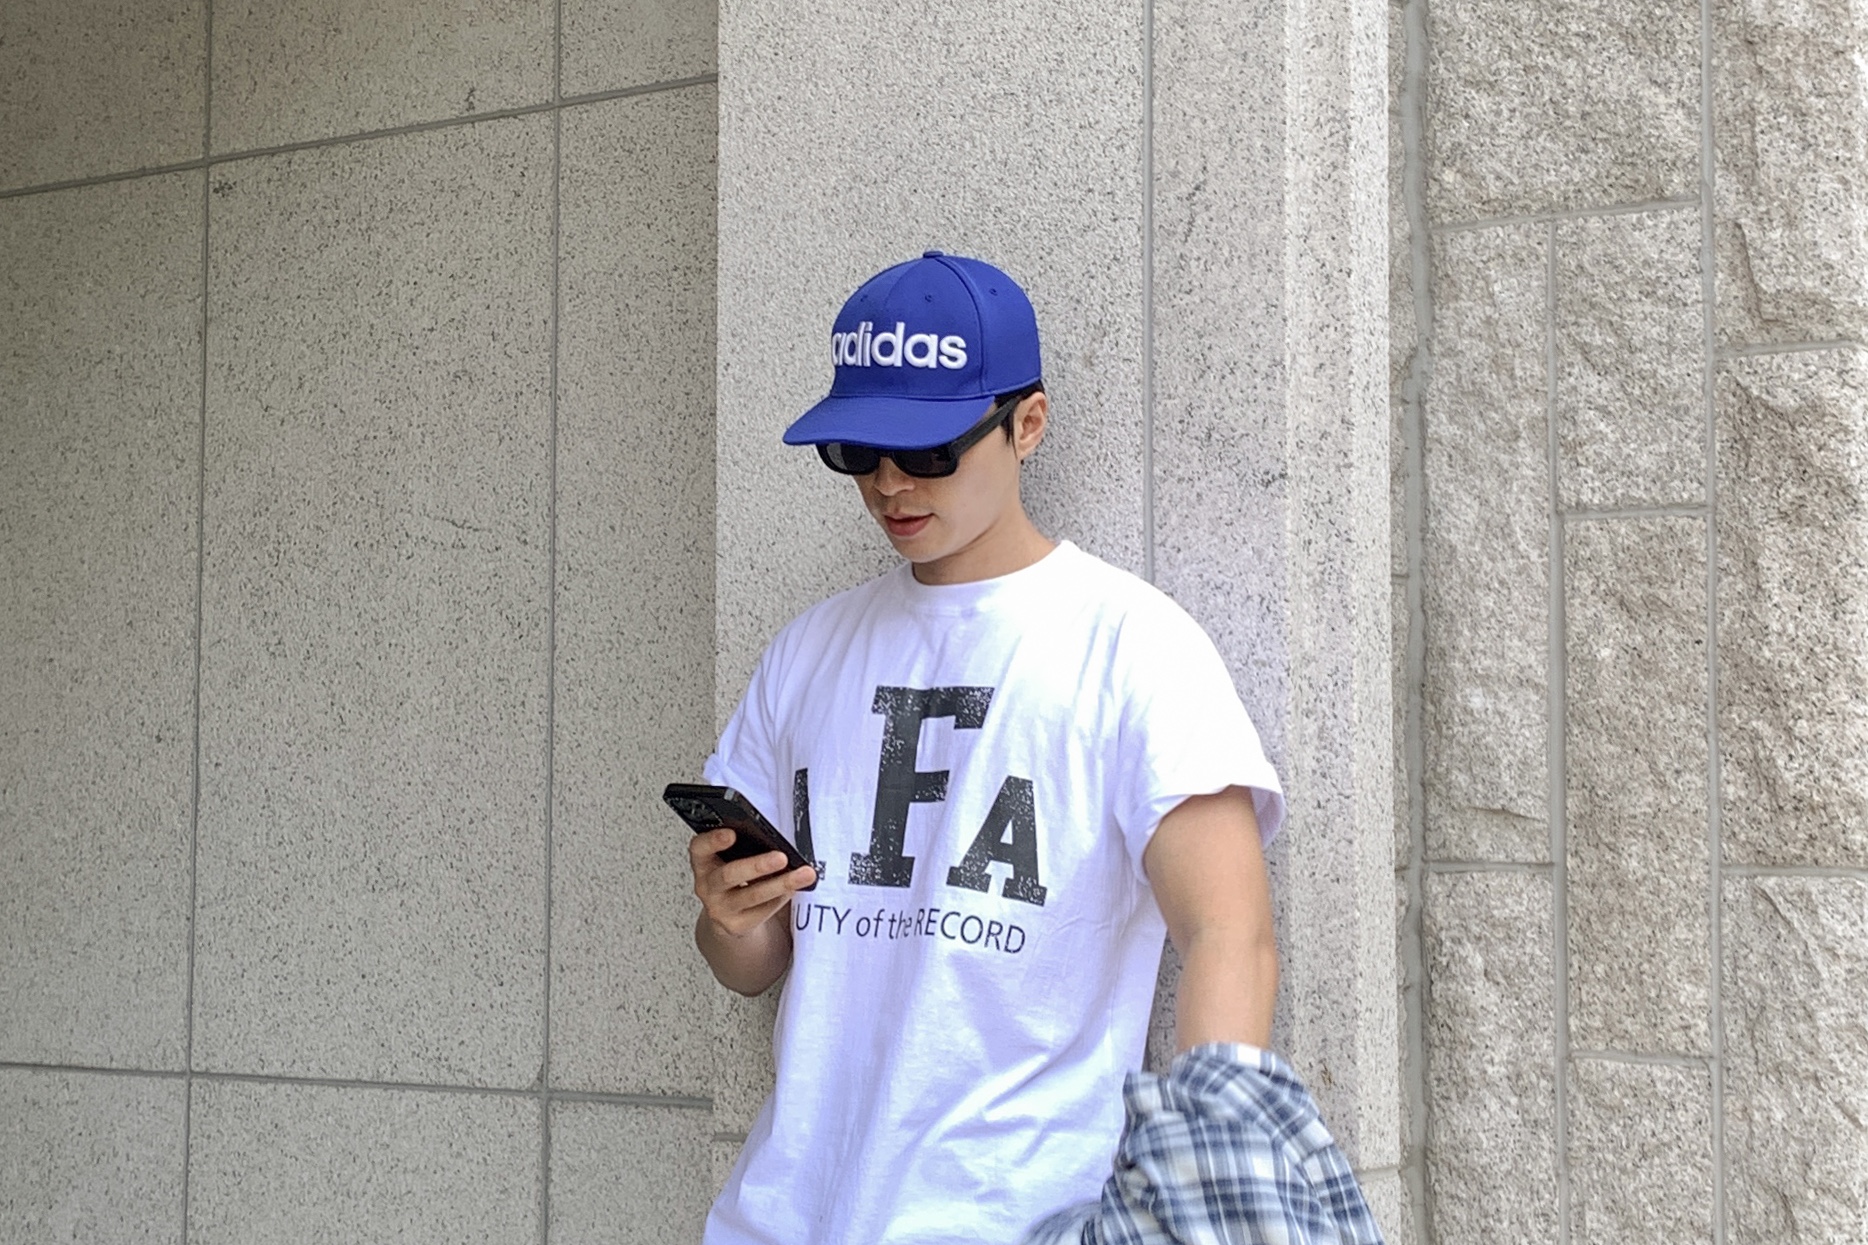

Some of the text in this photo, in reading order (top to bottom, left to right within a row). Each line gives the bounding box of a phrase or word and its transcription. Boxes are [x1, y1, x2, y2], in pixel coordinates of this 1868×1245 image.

[831, 321, 968, 369] adidas
[795, 903, 1026, 954] UTY of the RECORD
